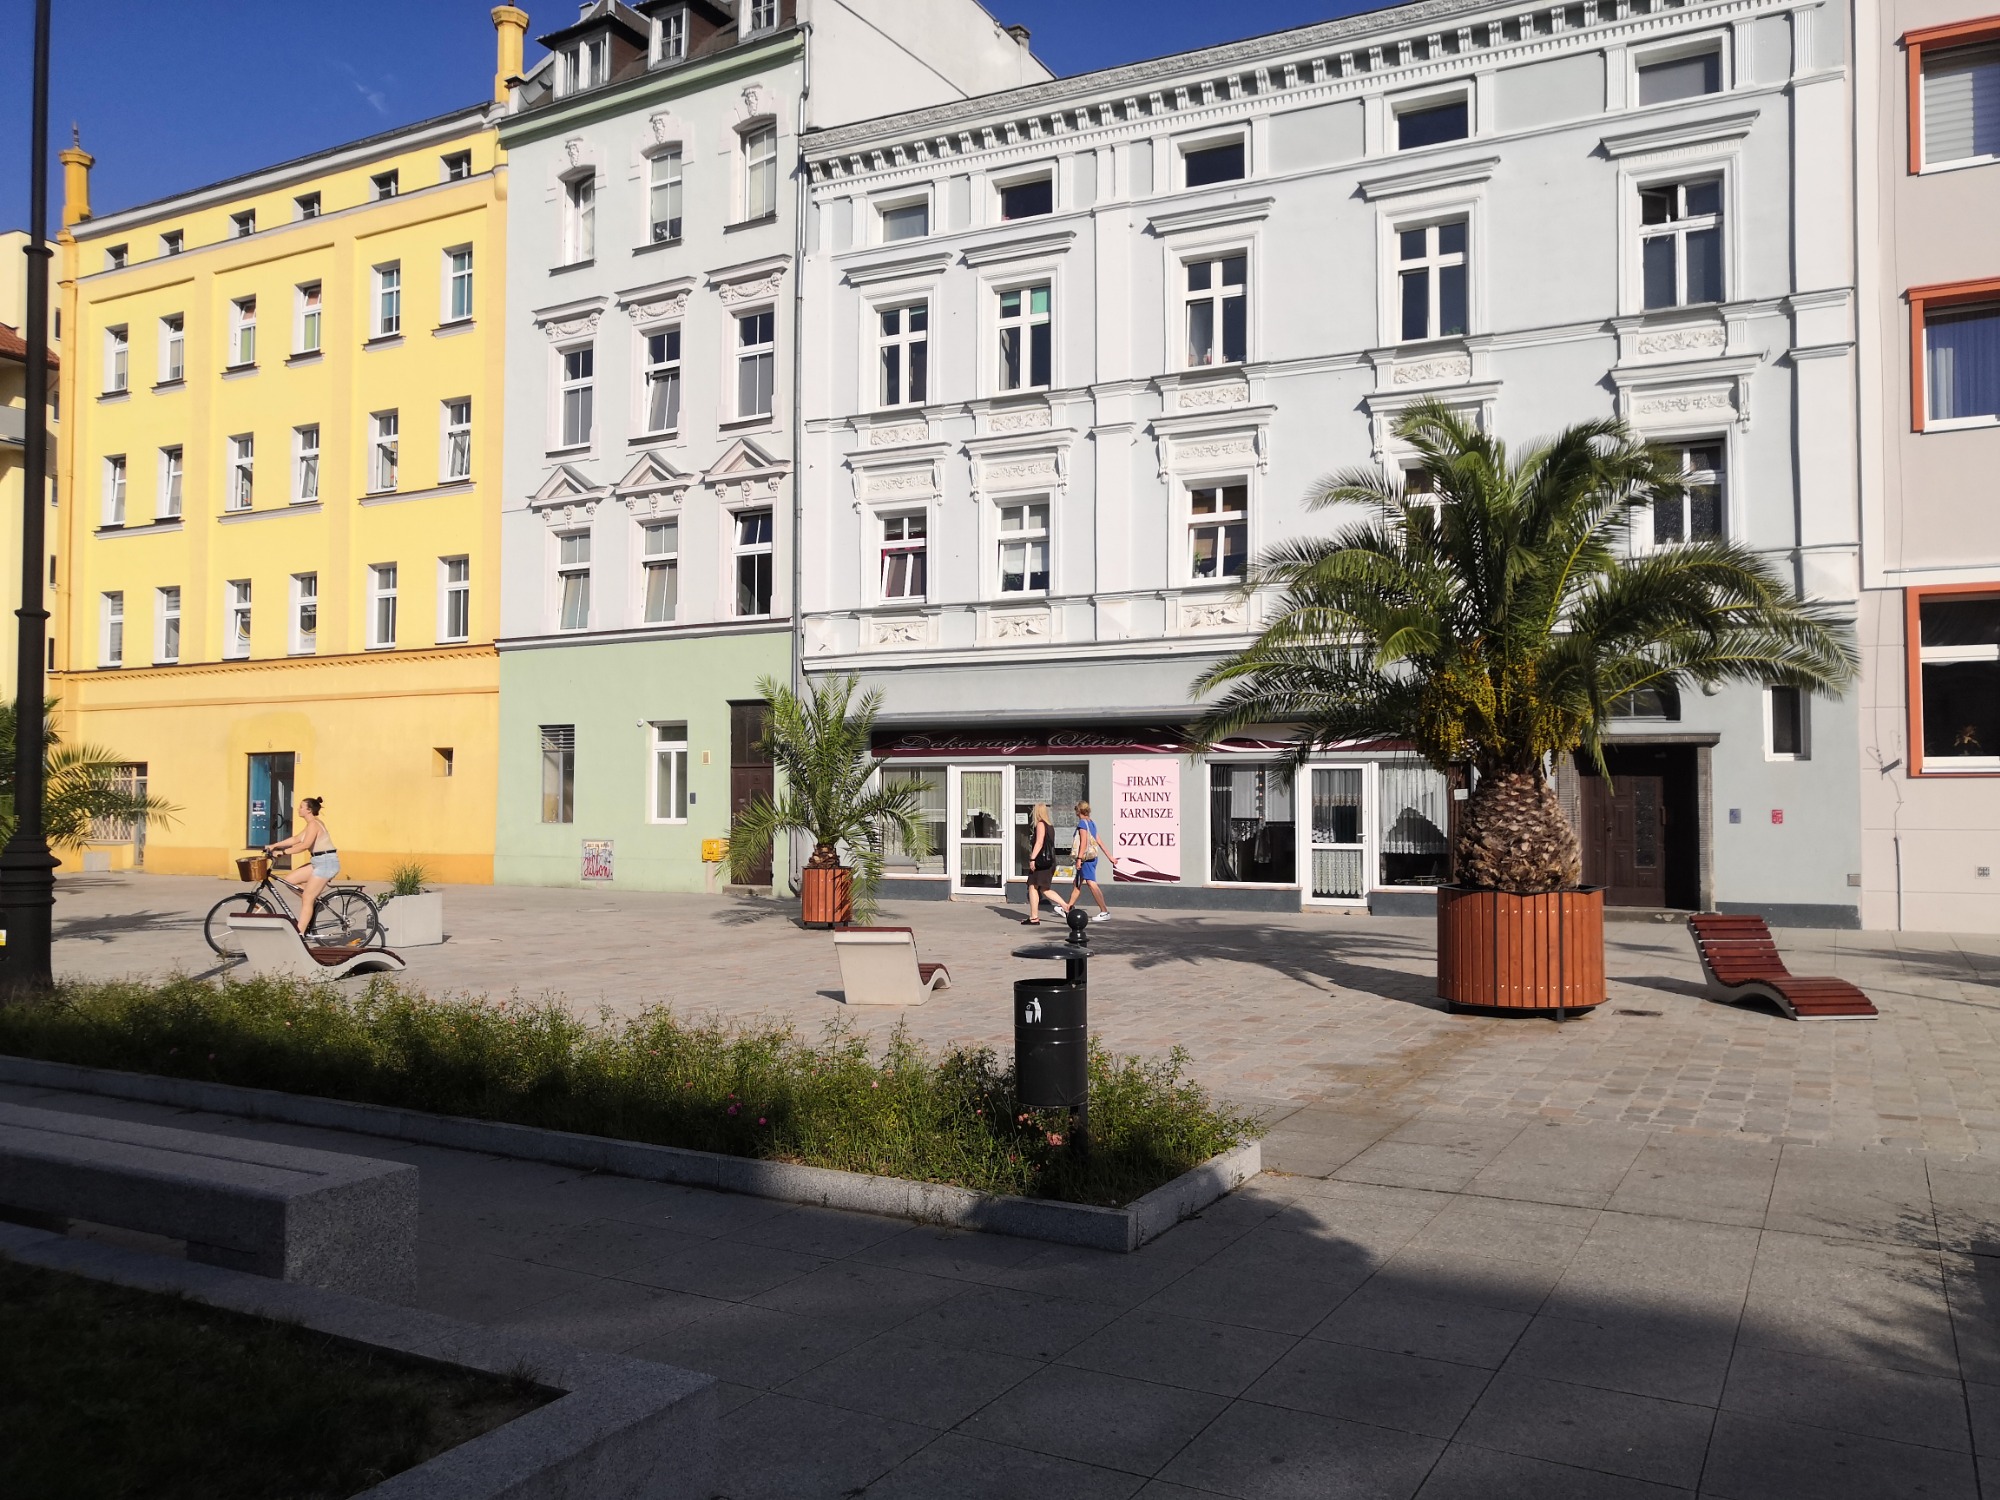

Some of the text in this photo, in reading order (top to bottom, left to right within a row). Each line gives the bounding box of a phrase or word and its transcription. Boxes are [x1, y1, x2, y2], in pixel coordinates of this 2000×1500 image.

[894, 731, 1136, 755] Dekoracje Okien
[1127, 776, 1166, 786] FIRANY
[1122, 792, 1171, 802] TKANINY
[1120, 808, 1173, 818] KARNISZE
[1119, 832, 1176, 847] SZYCIE
